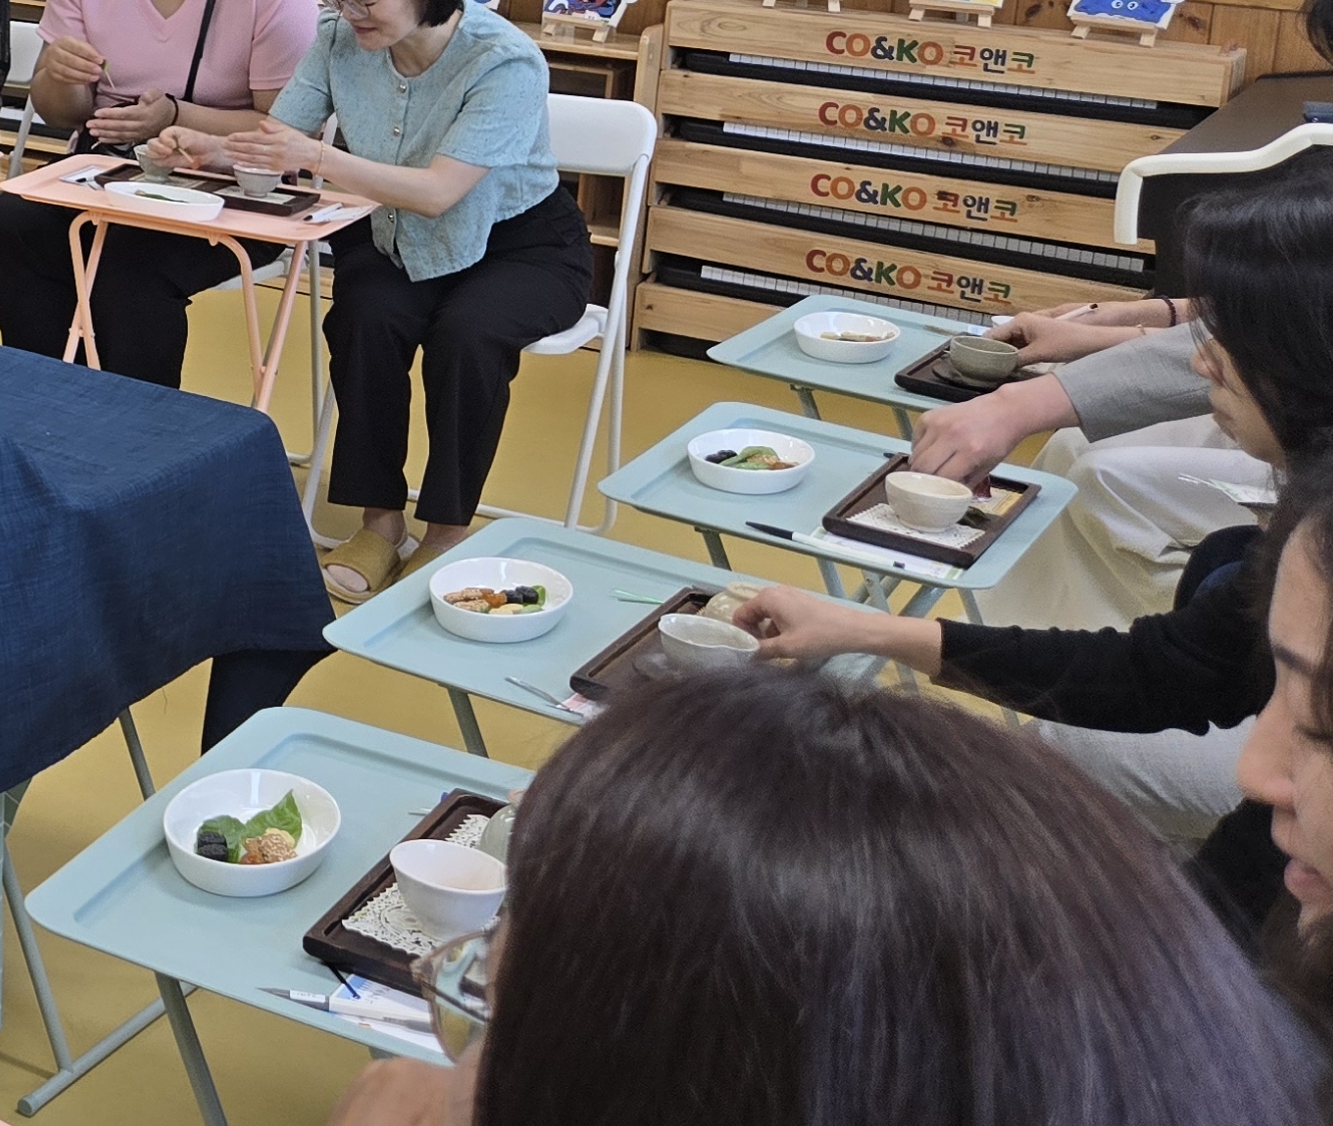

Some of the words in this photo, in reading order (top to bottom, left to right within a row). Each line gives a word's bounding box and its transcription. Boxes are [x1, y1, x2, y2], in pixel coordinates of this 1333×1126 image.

[825, 30, 944, 65] CO&KO
[949, 44, 1036, 74] 코앤코
[818, 101, 936, 136] CO&KO
[941, 115, 1028, 145] 코앤코
[810, 173, 927, 211] CO&KO
[933, 189, 1019, 223] 코앤코
[805, 249, 923, 290] CO&KO
[927, 270, 1013, 305] 코앤코
